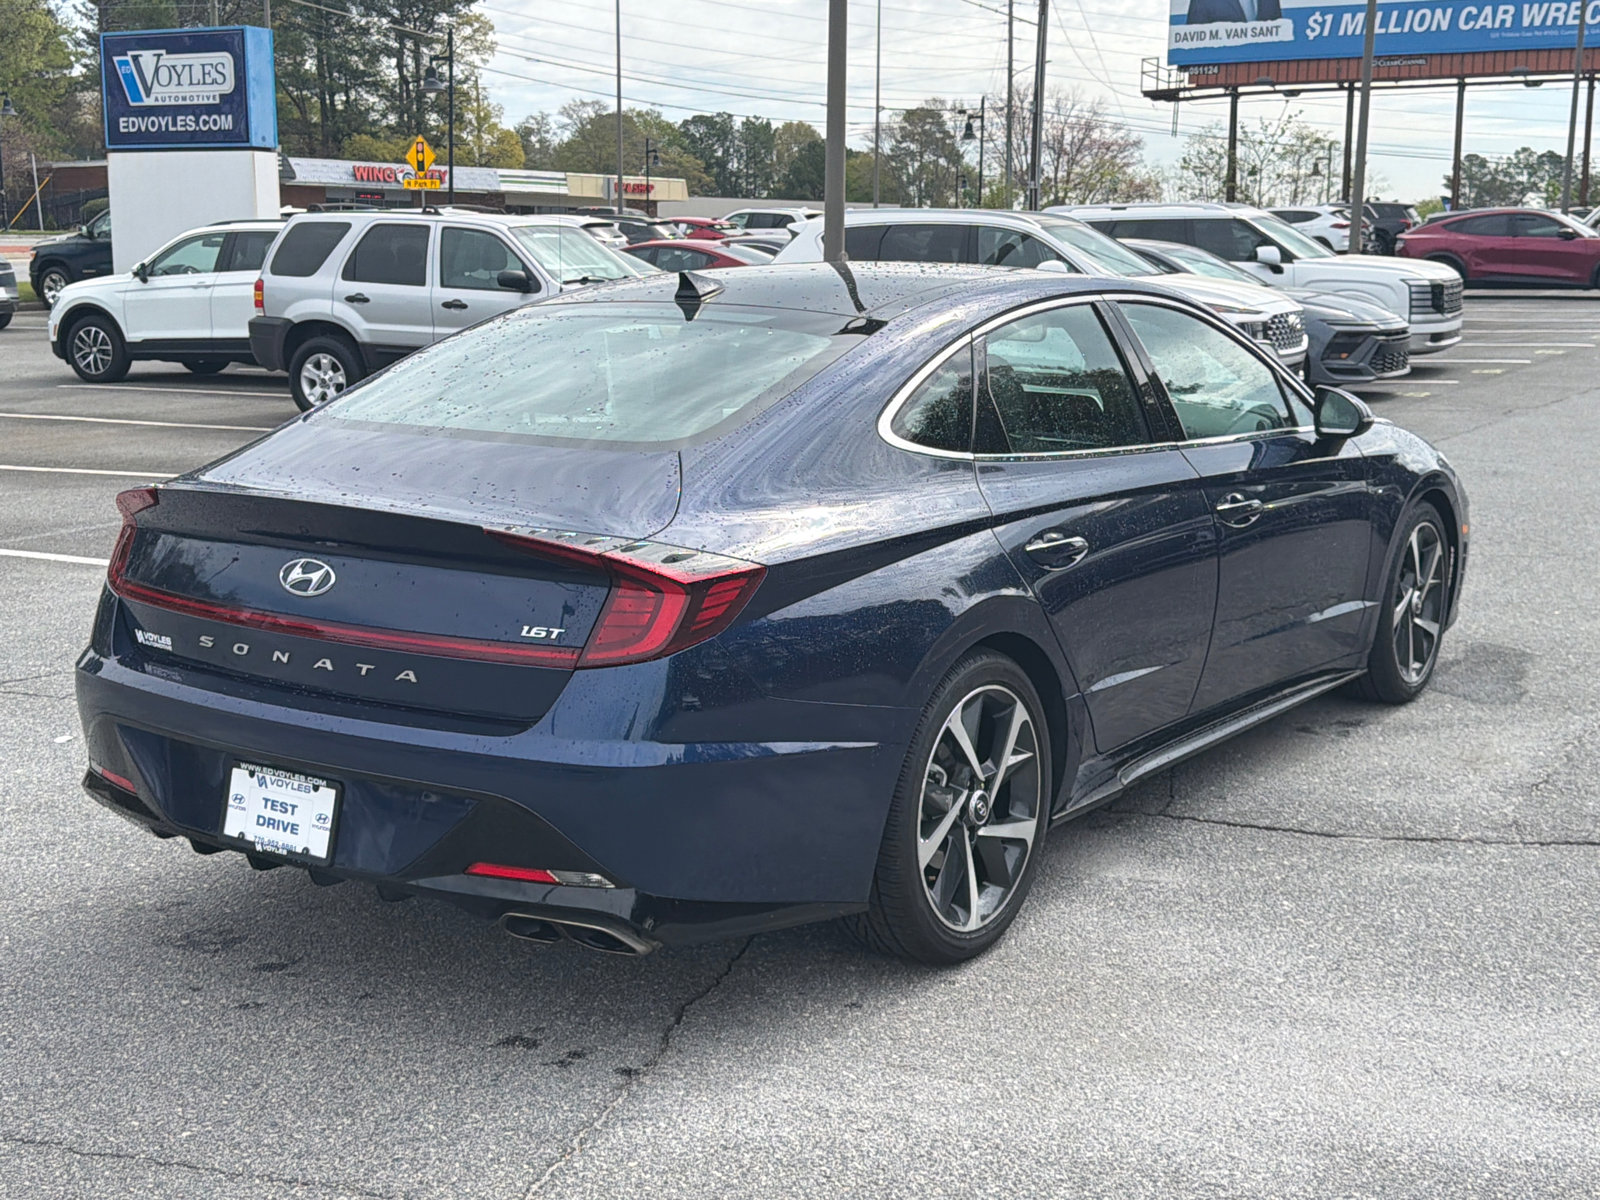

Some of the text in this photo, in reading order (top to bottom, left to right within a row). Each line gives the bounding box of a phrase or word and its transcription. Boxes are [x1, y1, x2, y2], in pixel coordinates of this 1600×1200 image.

[1305, 11, 1334, 40] $1
[1338, 7, 1453, 36] MLLION
[1458, 4, 1515, 31] CAR
[1522, 1, 1600, 28] WREC
[1174, 25, 1281, 43] DAVID M. VAN SANT
[130, 53, 227, 98] VOYLES
[154, 94, 218, 103] AUTOMOTIVE
[119, 114, 233, 133] EDVOYLES.COM
[353, 165, 396, 183] WING
[143, 631, 172, 646] VOYLES
[199, 635, 418, 683] SONATA
[240, 762, 327, 787] WWW.EDVOYLES.COM
[269, 777, 311, 794] VOYLES
[262, 797, 298, 816] TEST
[256, 814, 300, 835] DRIVE
